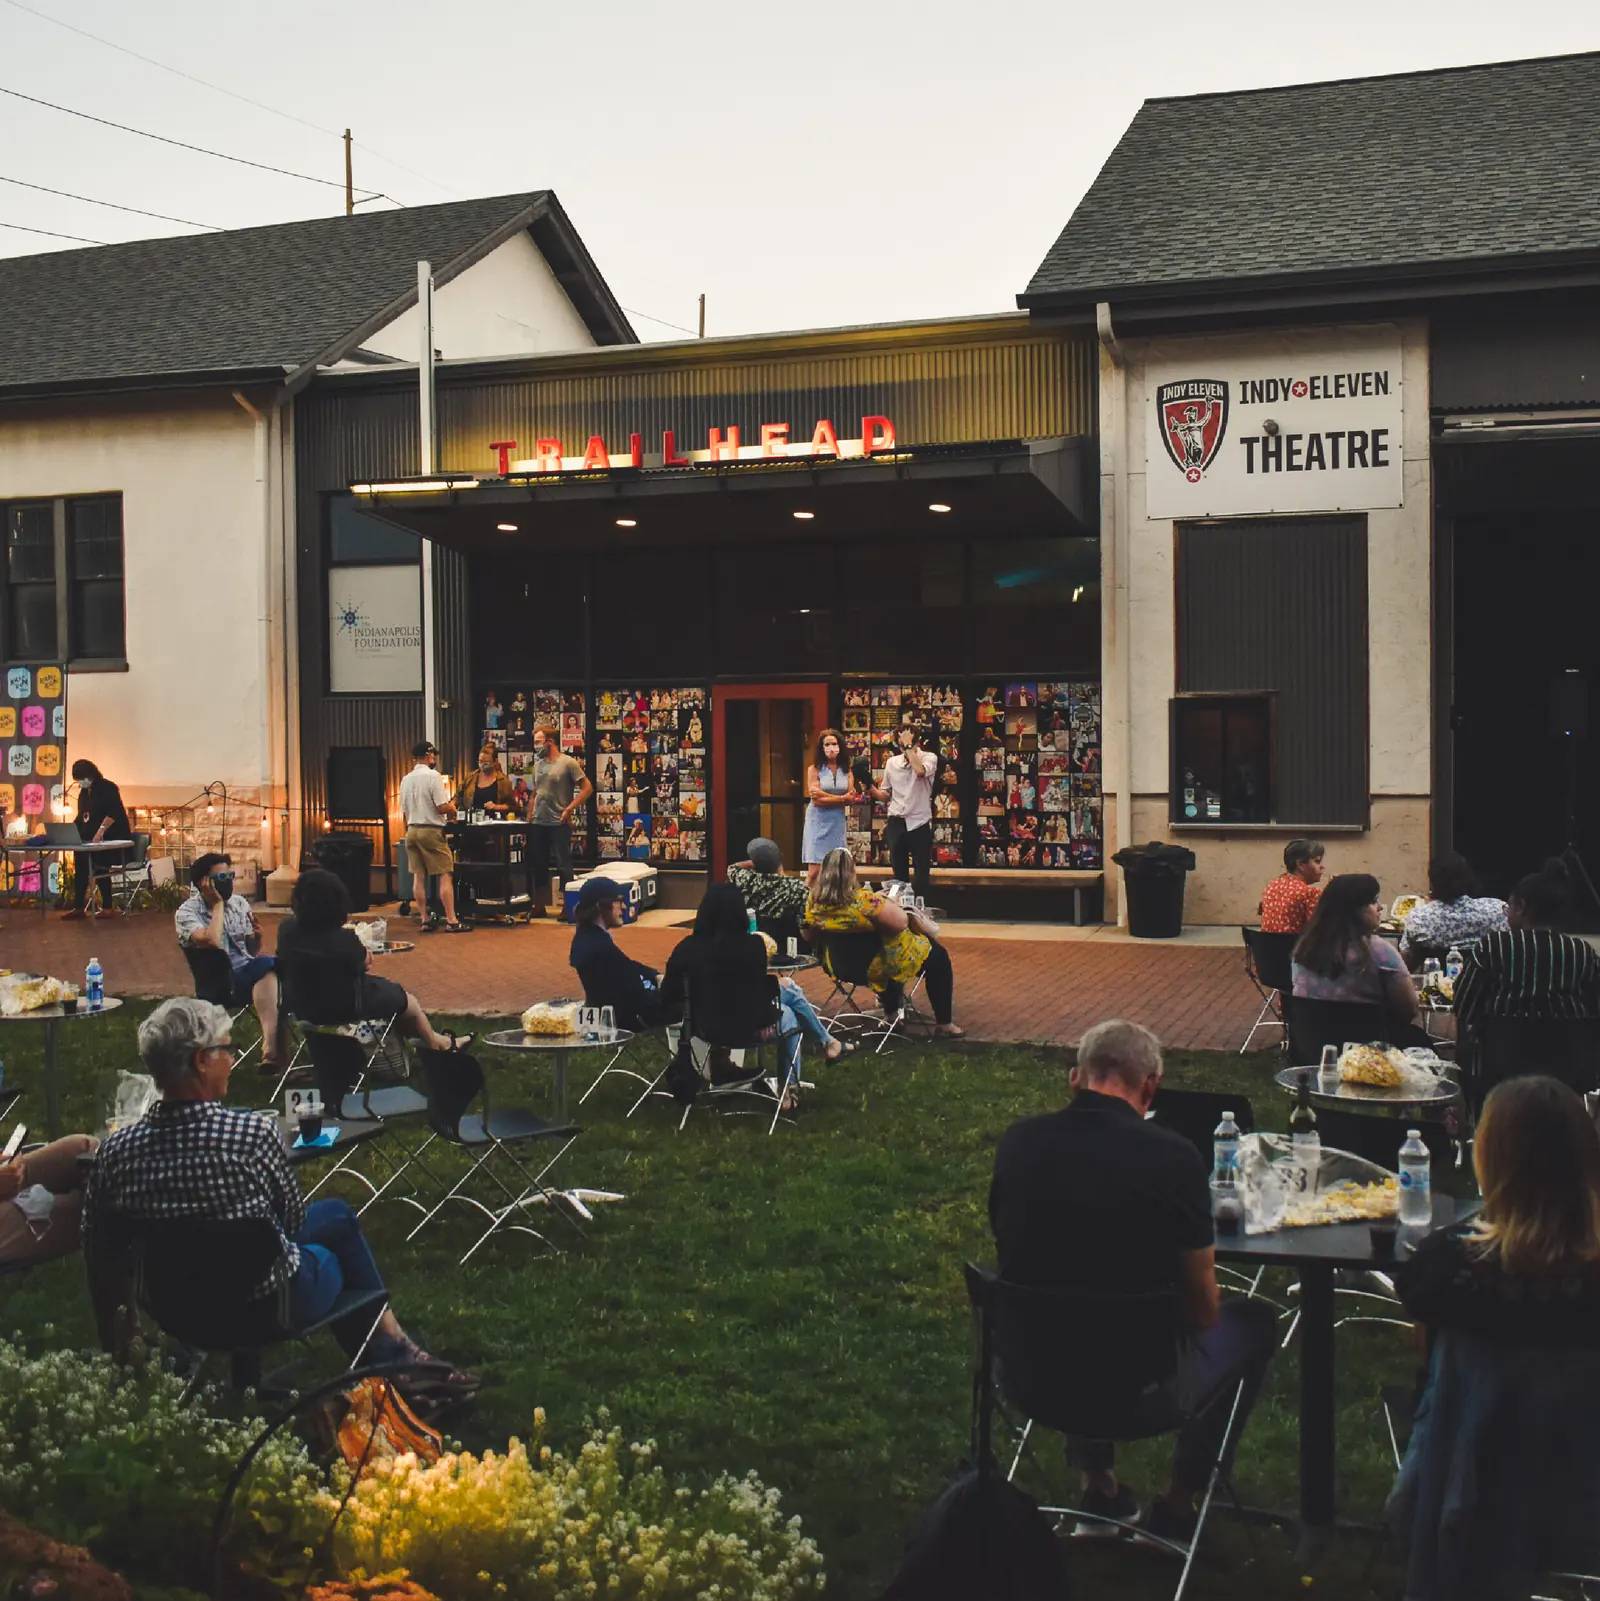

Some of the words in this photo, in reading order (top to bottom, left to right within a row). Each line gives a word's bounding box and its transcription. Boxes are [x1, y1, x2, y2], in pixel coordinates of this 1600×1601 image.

[1162, 383, 1187, 401] INDY
[1188, 383, 1224, 397] ELEVEN
[1239, 378, 1293, 405] INDY
[1309, 371, 1389, 400] ELEVEN
[489, 415, 896, 475] TRAILHEAD
[1239, 429, 1389, 474] THEATRE
[354, 626, 420, 637] INDIANAPOLIS
[354, 637, 420, 648] FOUNDATION
[578, 1009, 594, 1025] 14
